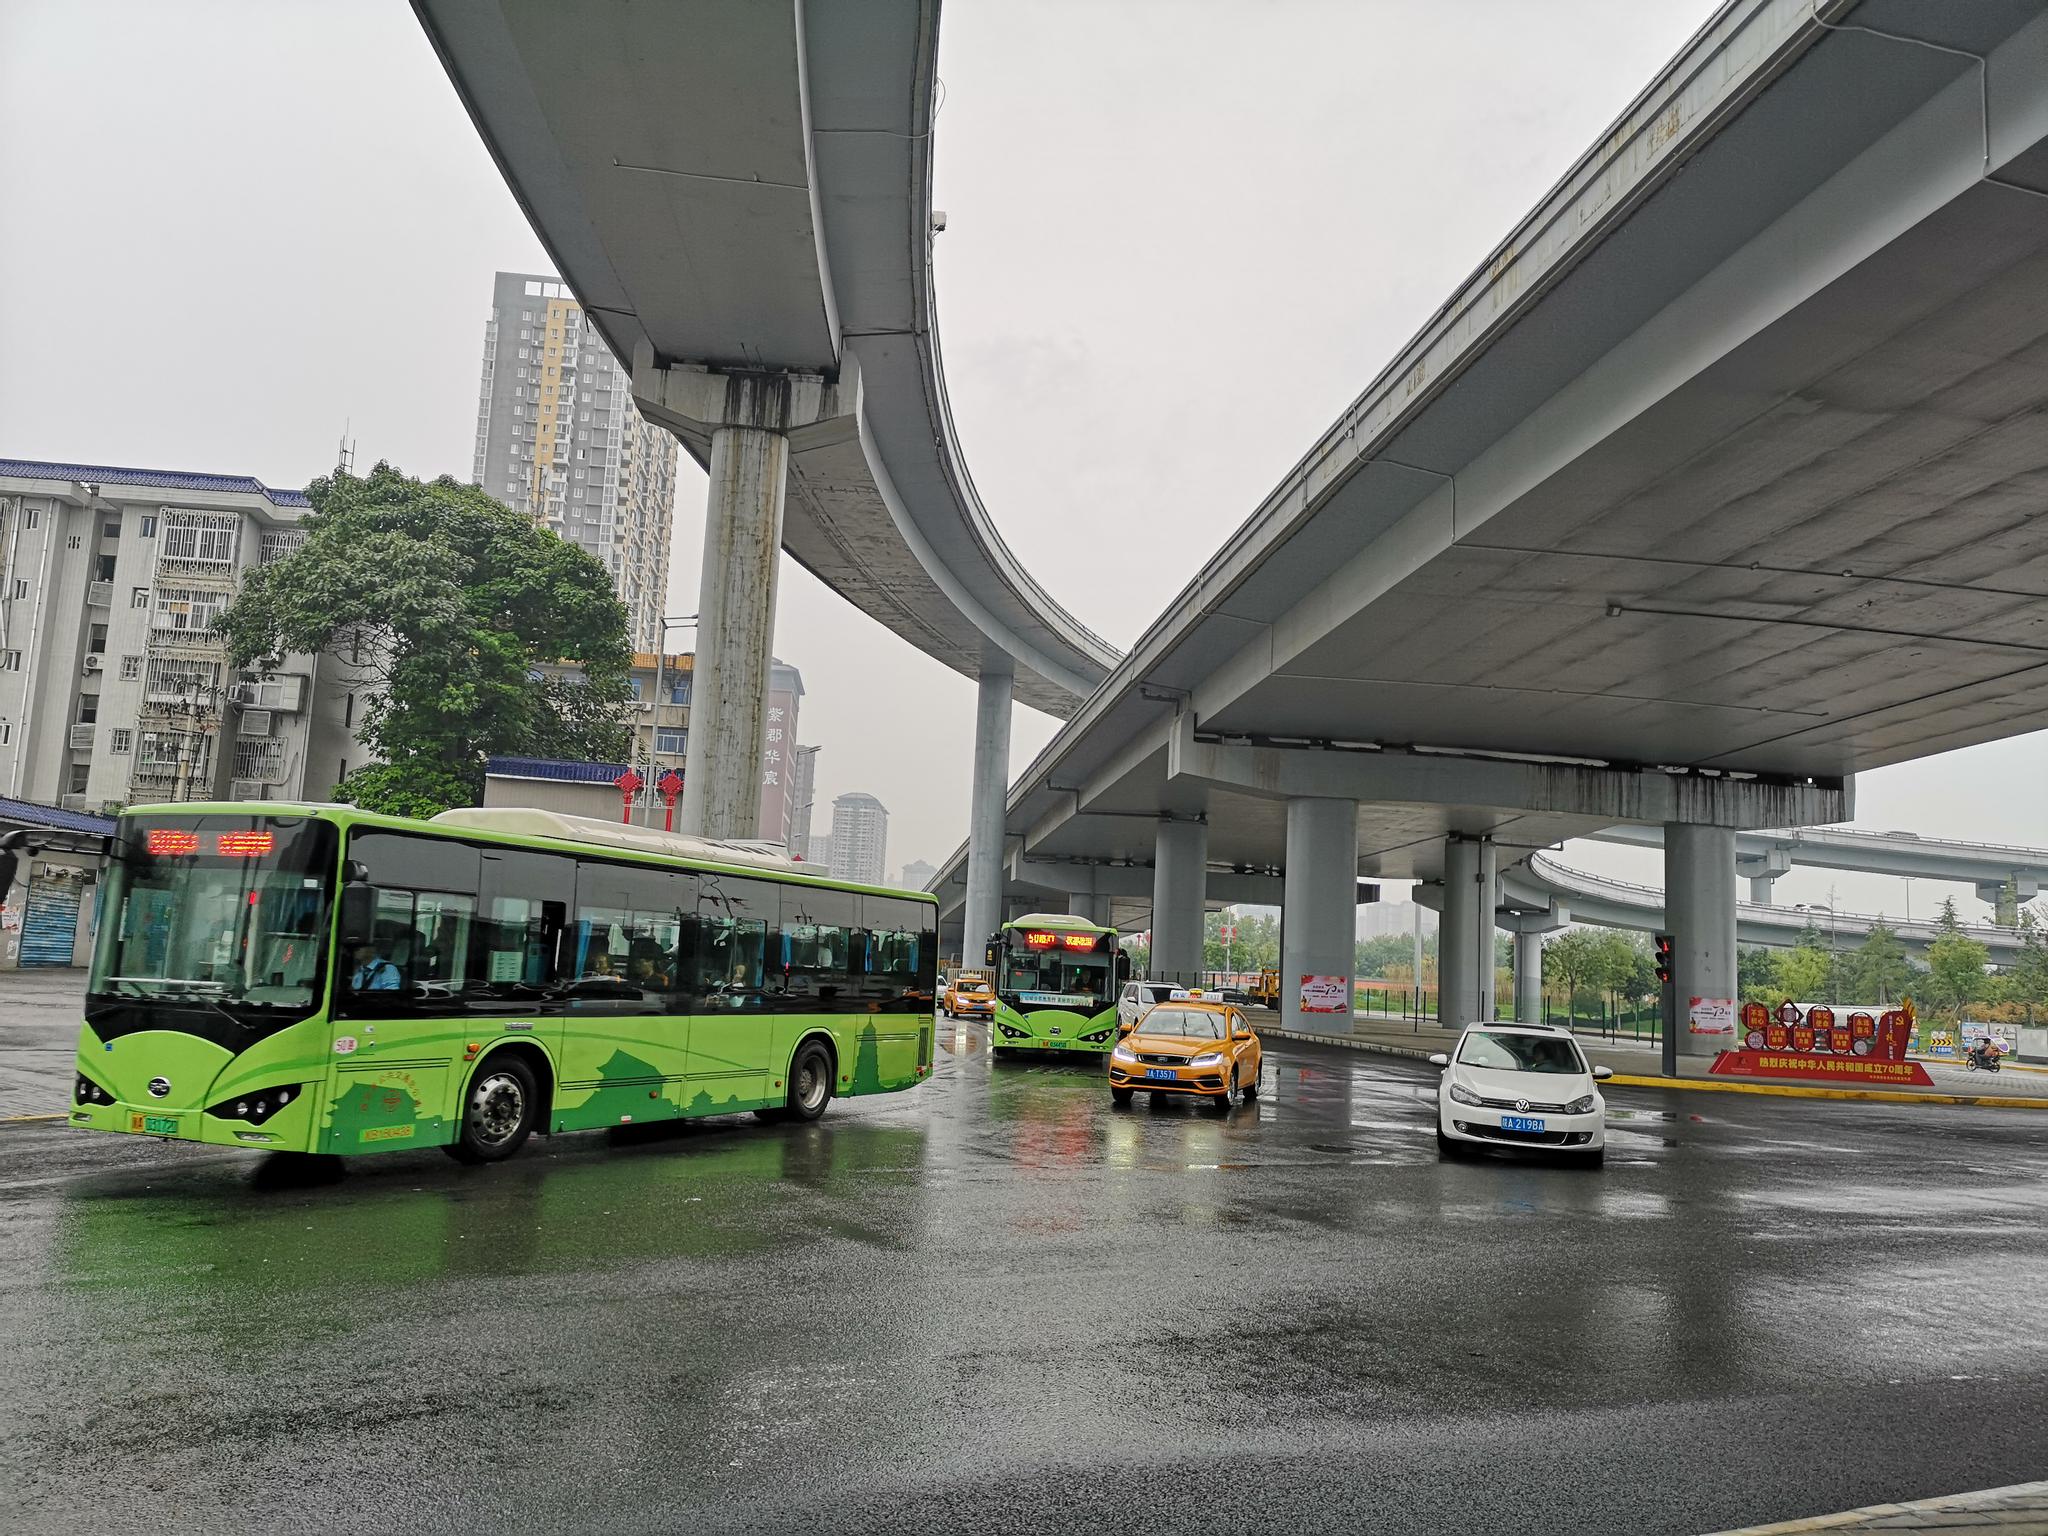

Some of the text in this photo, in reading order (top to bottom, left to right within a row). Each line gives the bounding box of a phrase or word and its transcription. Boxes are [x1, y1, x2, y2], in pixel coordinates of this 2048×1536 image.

[762, 706, 784, 786] 紫郡华宸
[1759, 1057, 1914, 1076] 热烈庆祝中华人民共和国成立70周年
